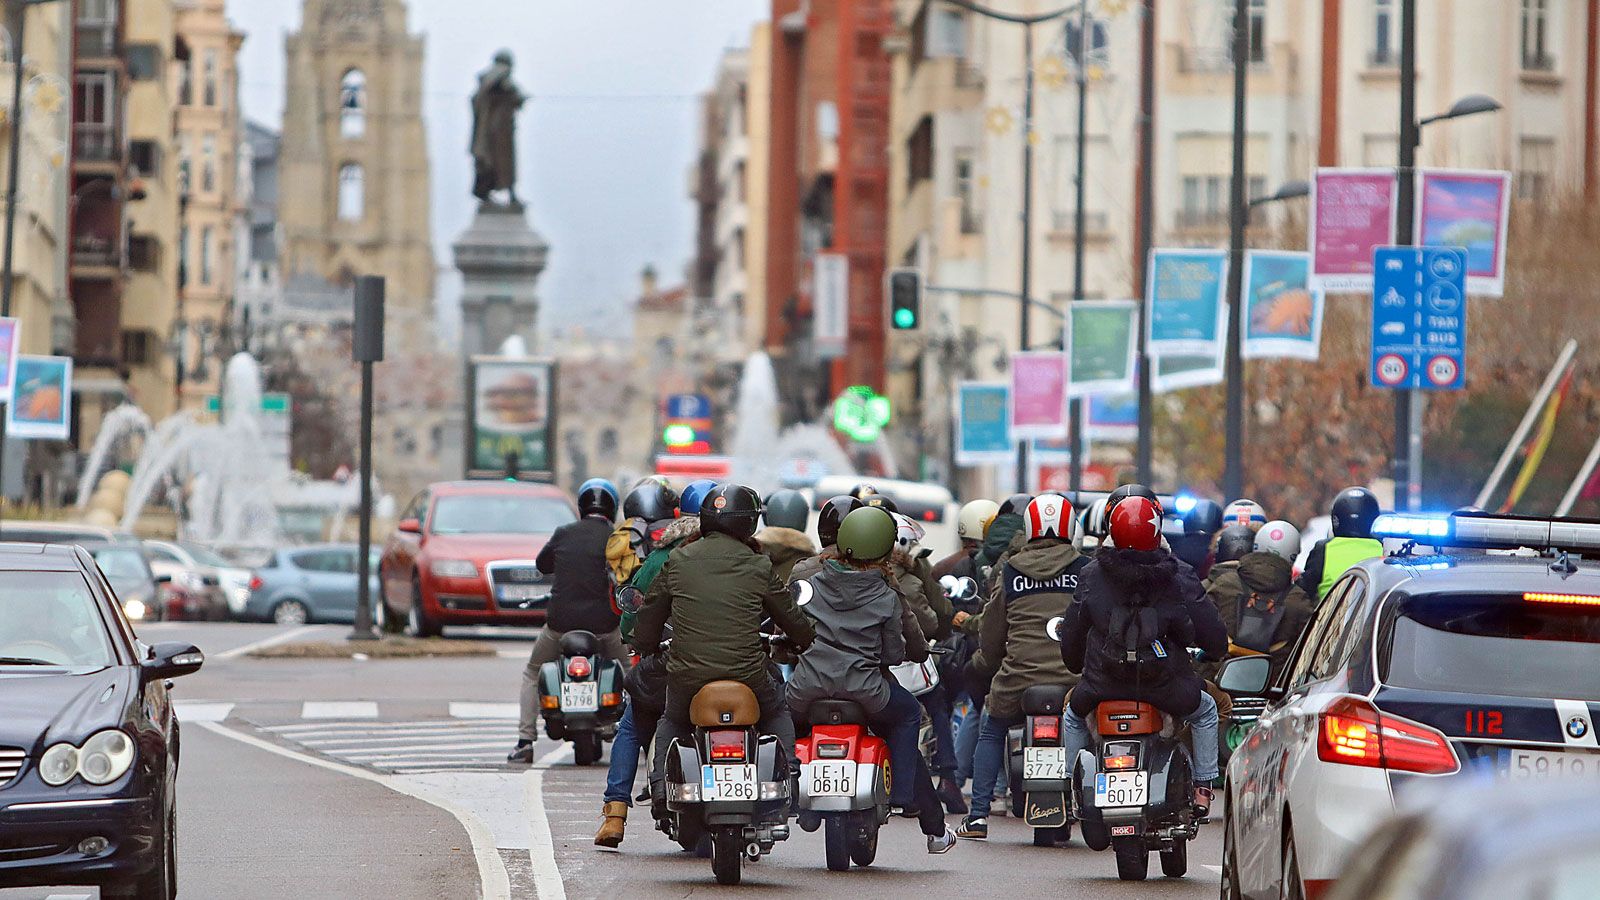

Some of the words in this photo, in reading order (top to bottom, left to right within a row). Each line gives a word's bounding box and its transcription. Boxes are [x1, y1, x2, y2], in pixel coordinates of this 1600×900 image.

[1428, 315, 1459, 328] TAXI
[1427, 332, 1457, 344] BUS
[565, 695, 593, 707] 5798
[1465, 710, 1503, 735] 112
[714, 767, 733, 782] LE
[743, 767, 752, 782] M
[1026, 763, 1064, 777] 3774
[716, 782, 753, 798] 1286
[813, 778, 850, 793] 0610
[1030, 803, 1061, 820] Vespa
